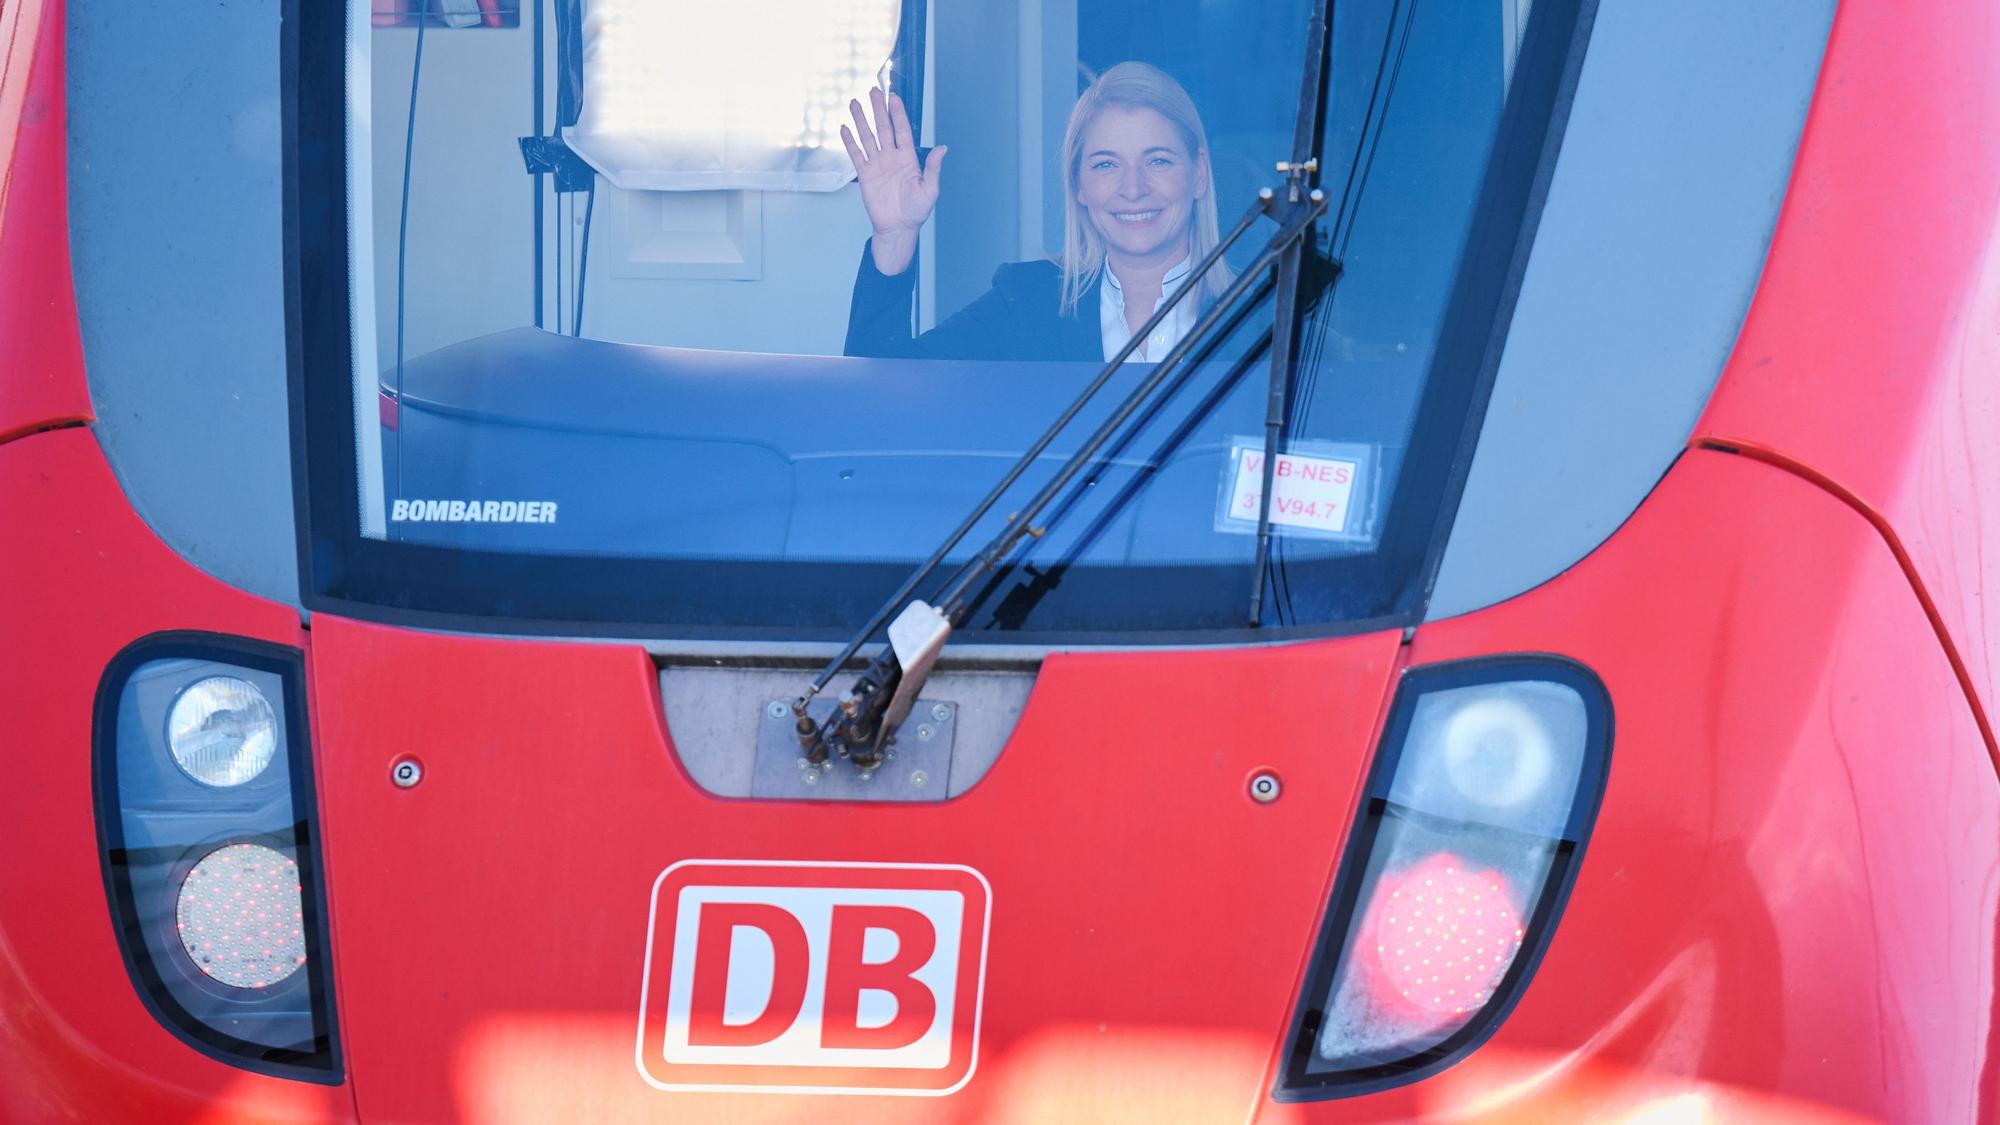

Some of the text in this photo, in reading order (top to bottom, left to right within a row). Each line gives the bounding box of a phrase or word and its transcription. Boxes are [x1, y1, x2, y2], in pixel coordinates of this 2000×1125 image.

[1245, 455, 1349, 484] VB-NES
[391, 499, 558, 524] BOMBARDIER
[687, 902, 937, 1050] DB
